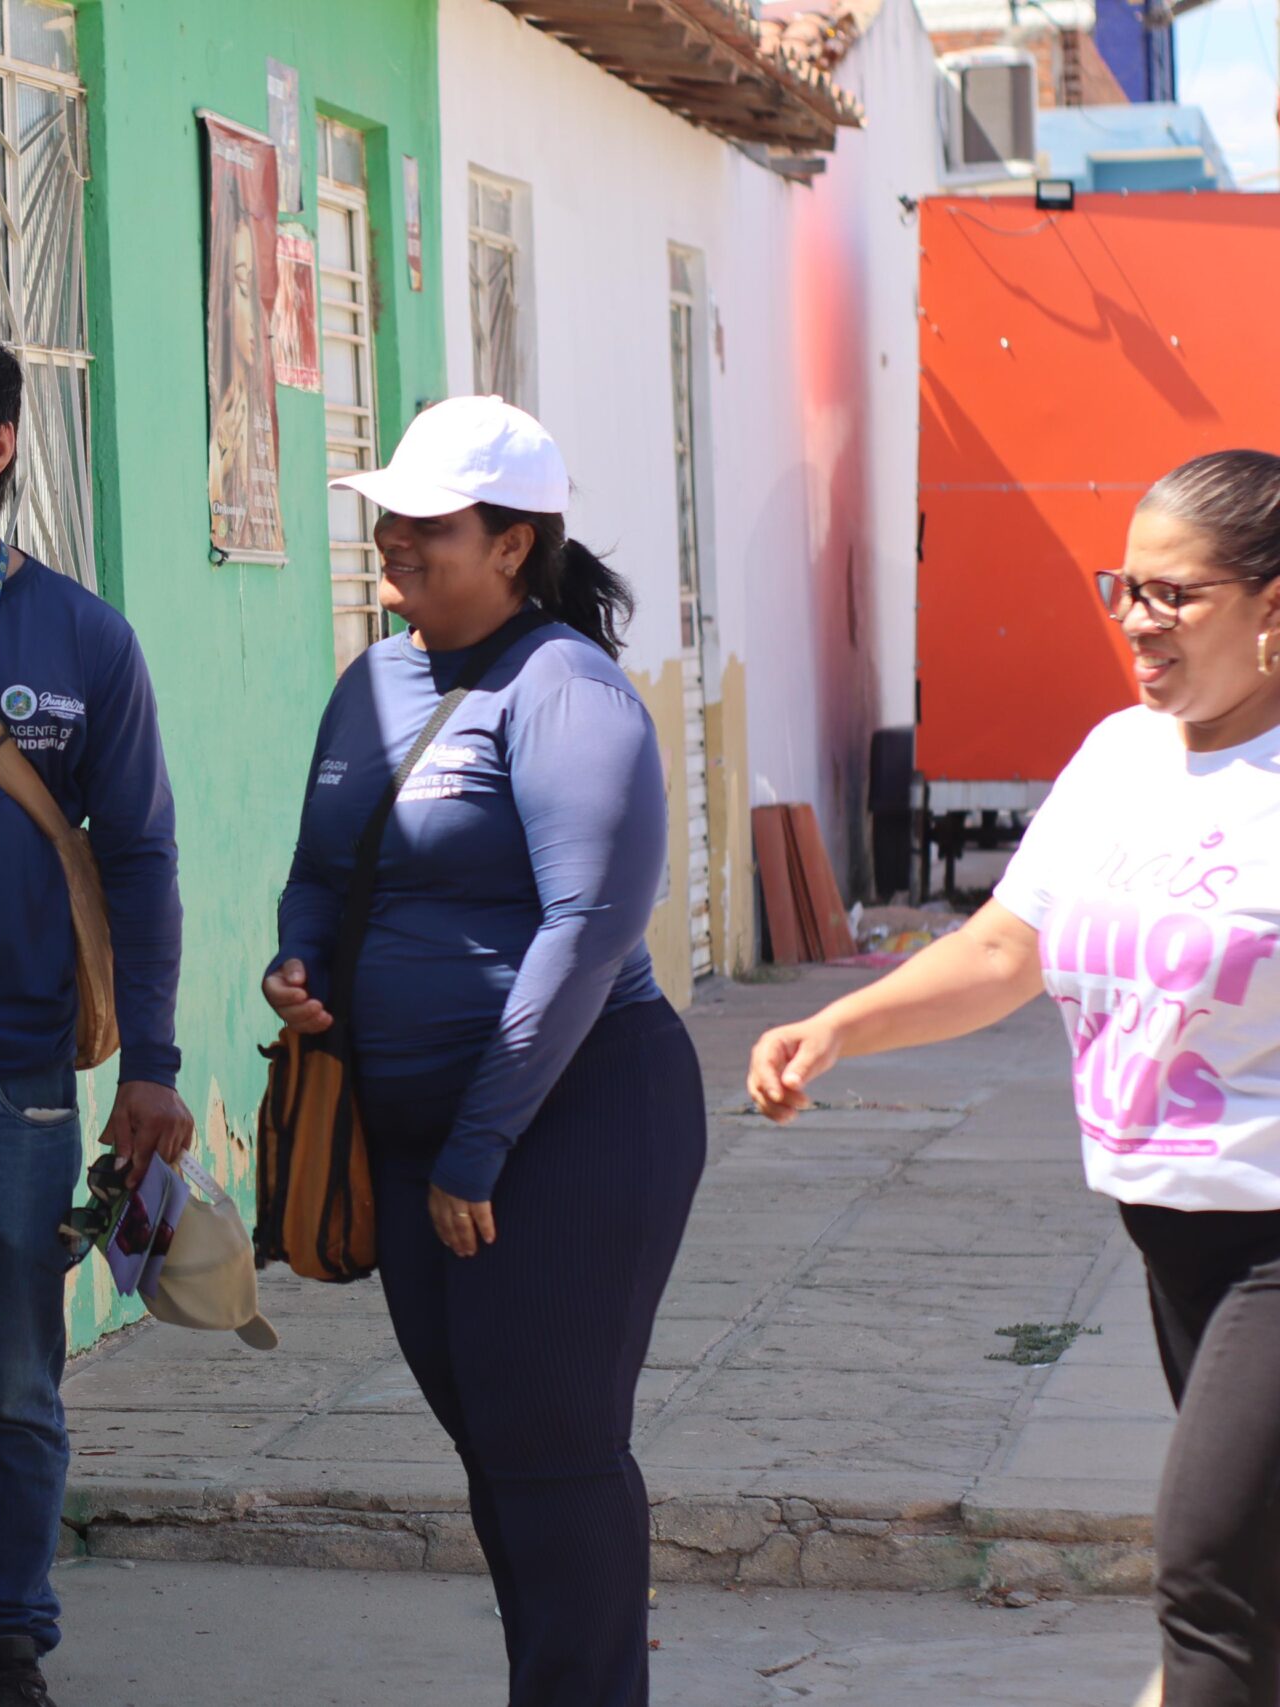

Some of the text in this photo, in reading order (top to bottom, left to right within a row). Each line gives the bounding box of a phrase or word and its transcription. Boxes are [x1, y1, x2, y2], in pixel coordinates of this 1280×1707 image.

[10, 724, 58, 737] AGENTE
[17, 737, 68, 751] NDEMIA
[443, 773, 464, 787] DE
[1039, 898, 1278, 1007] mor
[1073, 1012, 1226, 1130] las
